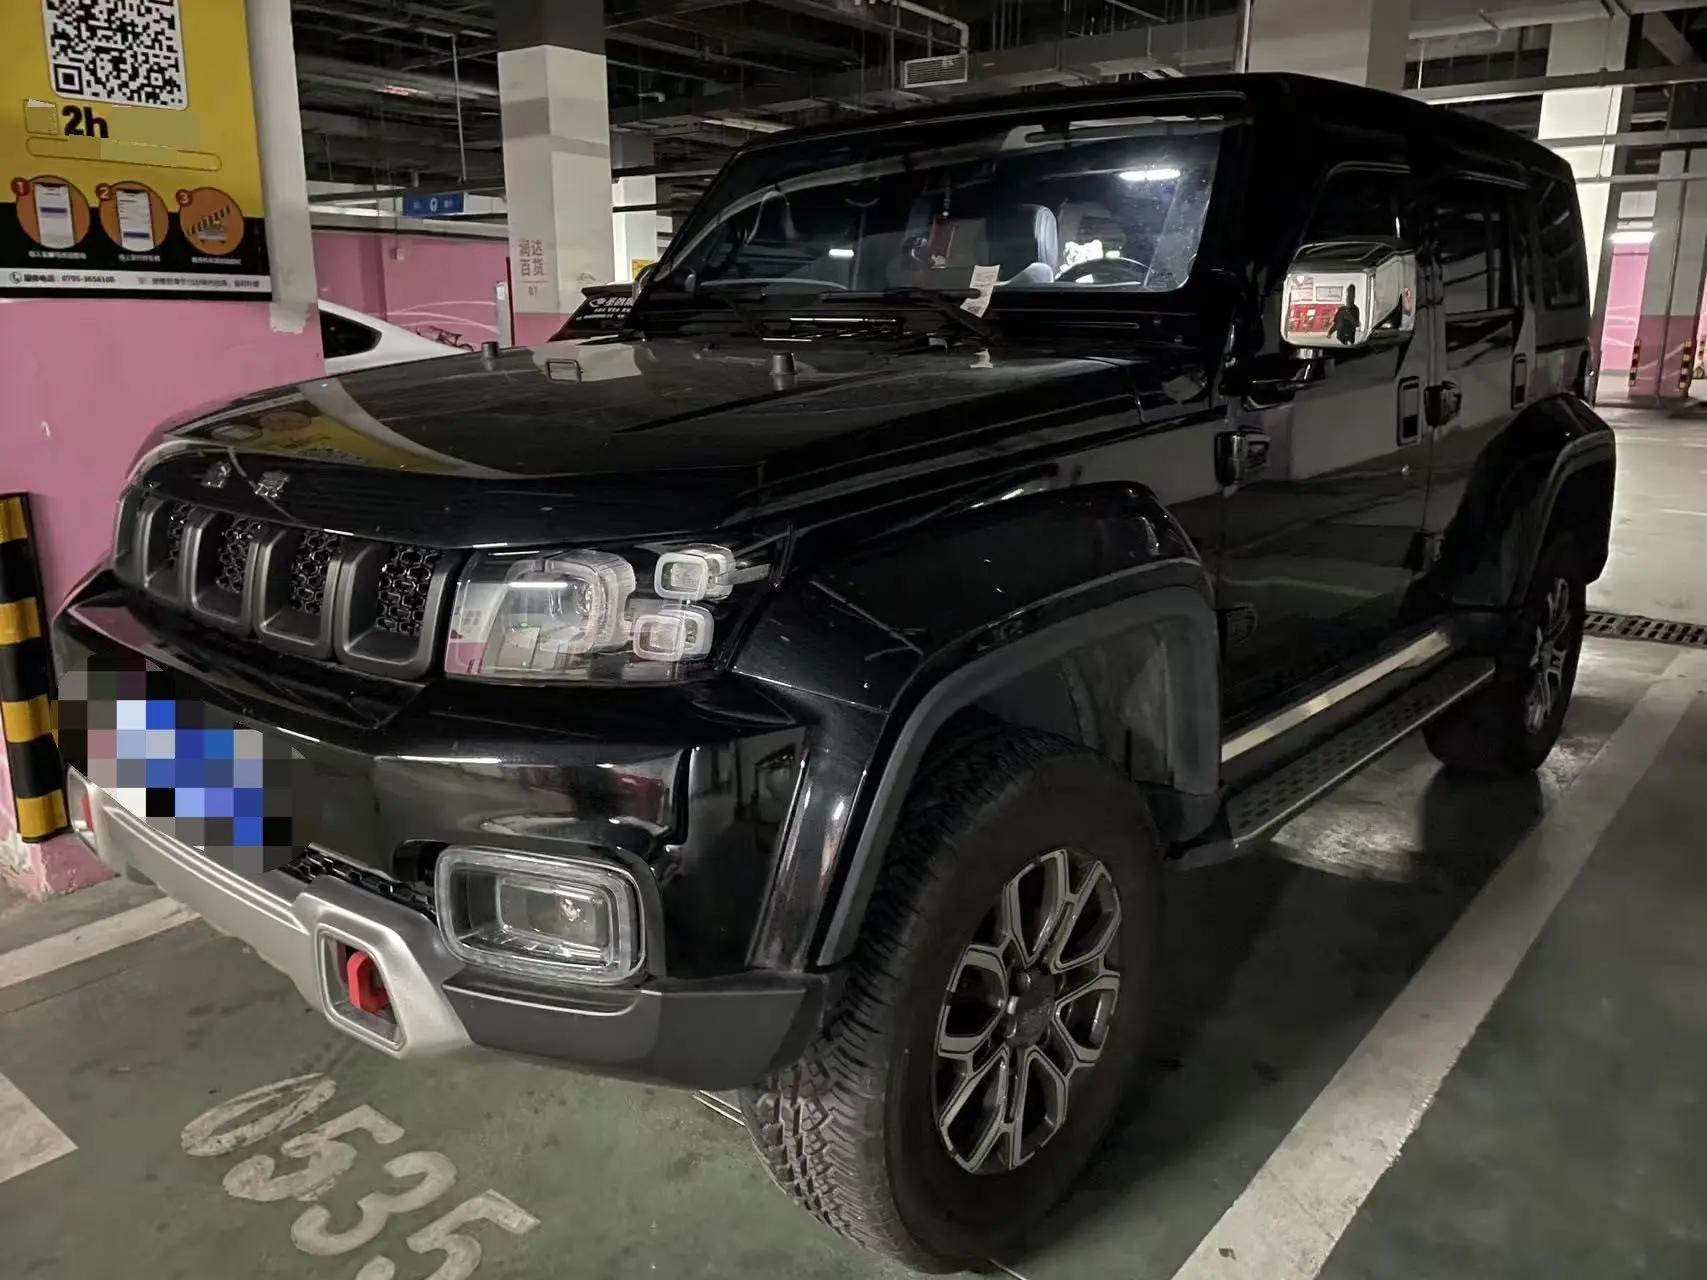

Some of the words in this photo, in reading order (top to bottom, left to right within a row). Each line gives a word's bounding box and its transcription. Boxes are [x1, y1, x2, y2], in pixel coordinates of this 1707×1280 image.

[61, 104, 109, 138] 2h
[17, 180, 26, 194] 1
[99, 186, 110, 199] 2
[179, 191, 190, 203] 3
[519, 258, 545, 277] 百货
